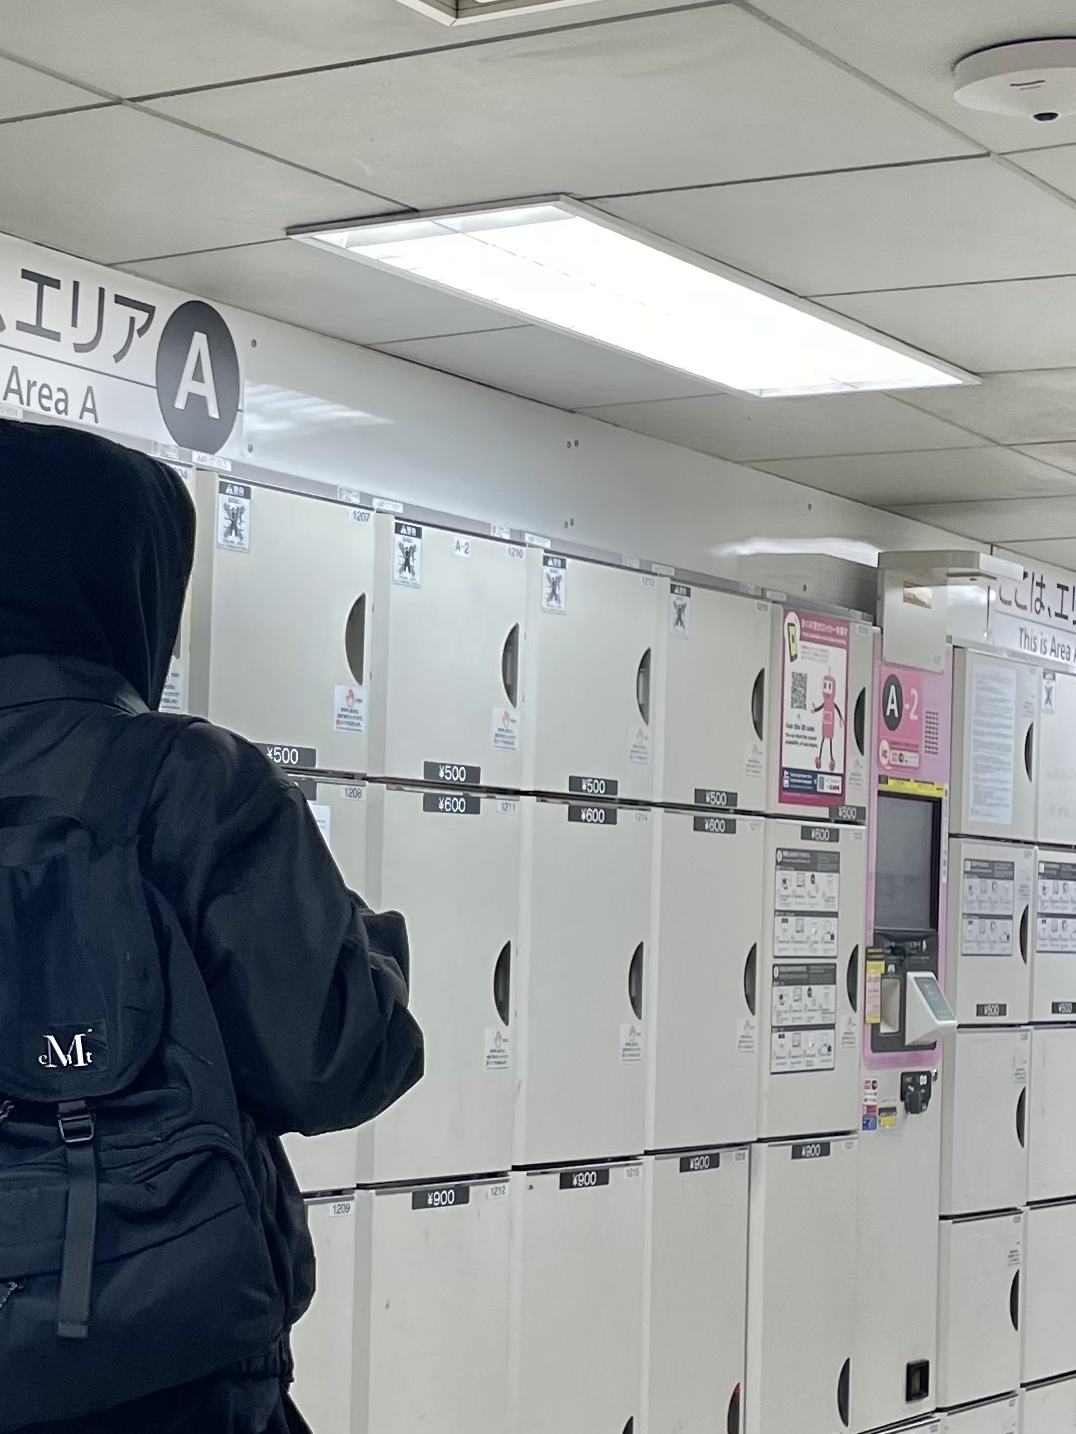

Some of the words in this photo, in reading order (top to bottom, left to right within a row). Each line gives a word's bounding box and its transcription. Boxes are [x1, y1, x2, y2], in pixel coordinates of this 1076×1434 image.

[174, 332, 220, 420] A
[3, 365, 69, 416] Area
[79, 385, 100, 424] A
[455, 539, 471, 555] A-2
[1019, 627, 1037, 653] This
[1040, 631, 1047, 656] is
[1051, 636, 1071, 662] Area
[267, 746, 299, 764] ¥500
[439, 765, 466, 782] ¥500
[582, 778, 606, 794] ¥500
[438, 797, 466, 813] ¥600
[705, 792, 726, 806] ¥500
[581, 808, 605, 823] ¥600
[838, 806, 857, 820] ¥500
[704, 819, 725, 833] ¥600
[811, 828, 830, 841] ¥600
[801, 1143, 822, 1158] ¥900
[690, 1155, 710, 1170] ¥900
[573, 1171, 597, 1187] ¥900
[427, 1189, 455, 1206] ¥900
